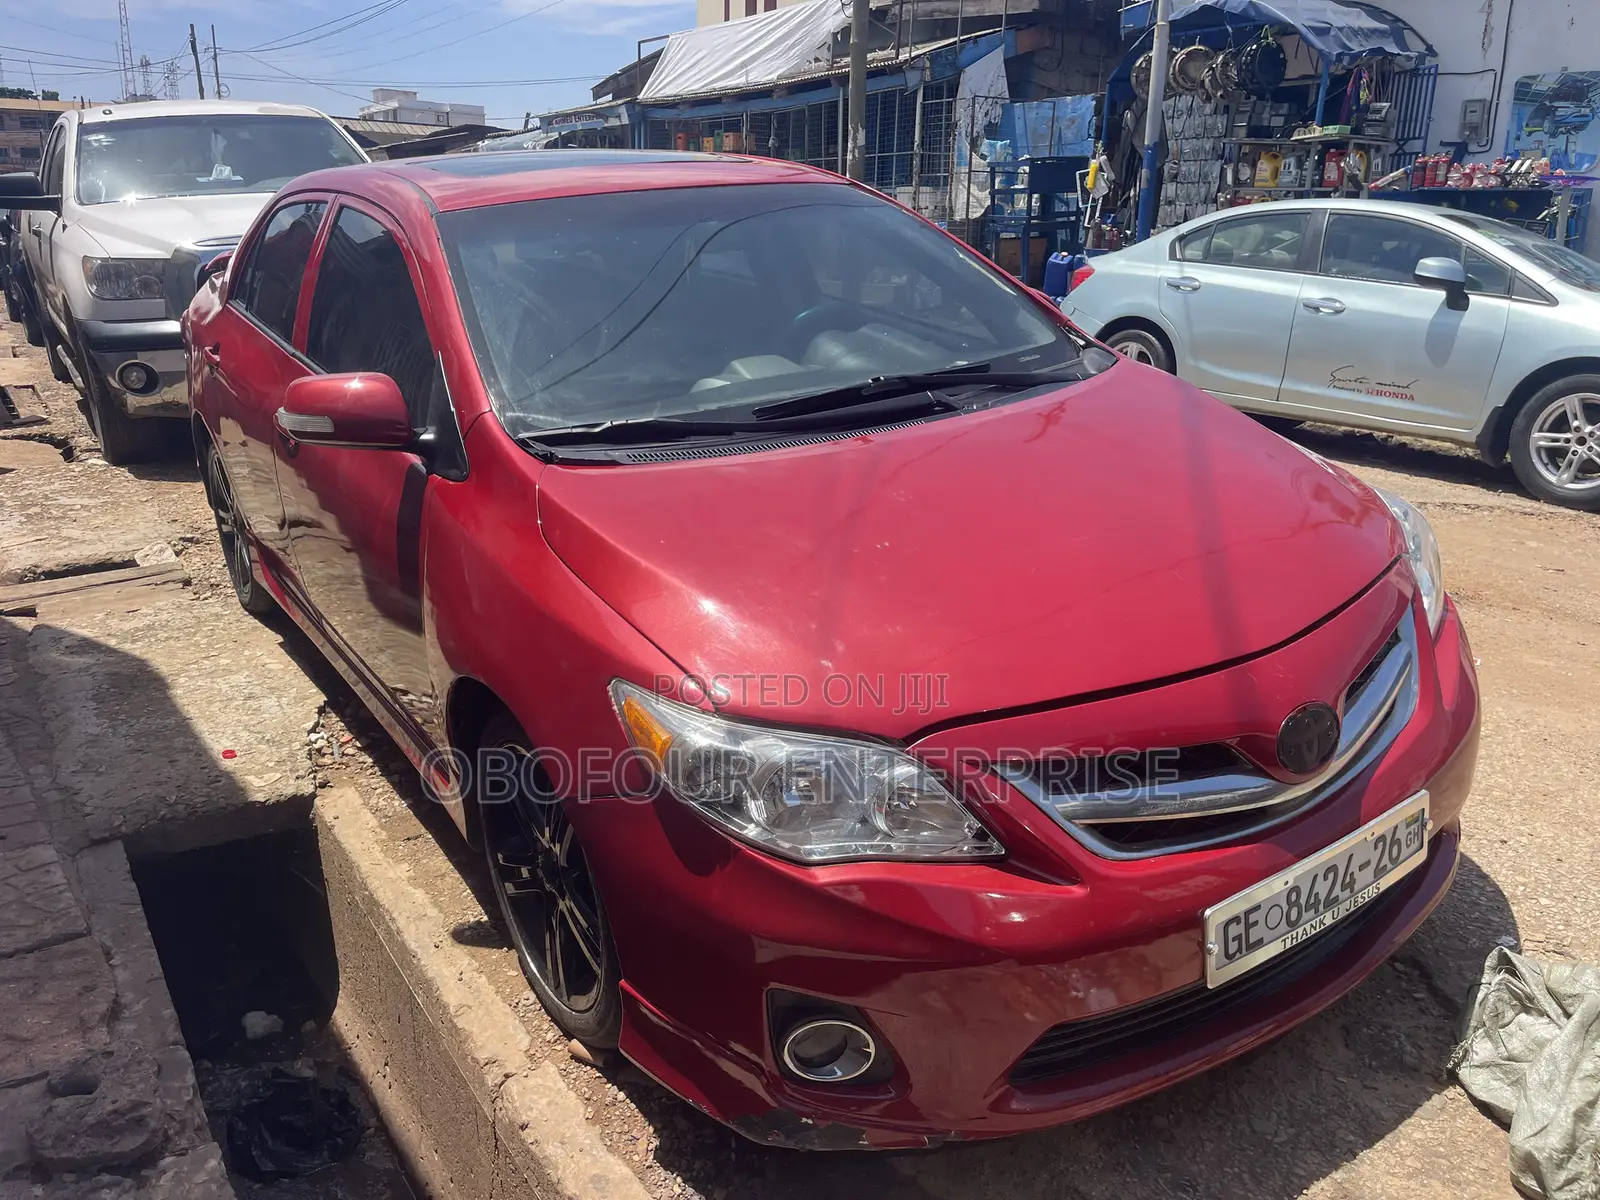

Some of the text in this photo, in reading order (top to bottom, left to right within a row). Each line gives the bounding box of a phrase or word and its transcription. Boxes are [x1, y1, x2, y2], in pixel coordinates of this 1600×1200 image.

[555, 115, 573, 125] AHMED
[1332, 384, 1355, 393] Produced
[1375, 389, 1415, 401] HONDA
[1223, 904, 1264, 962] GE
[1280, 882, 1381, 950] THANK U JESUS
